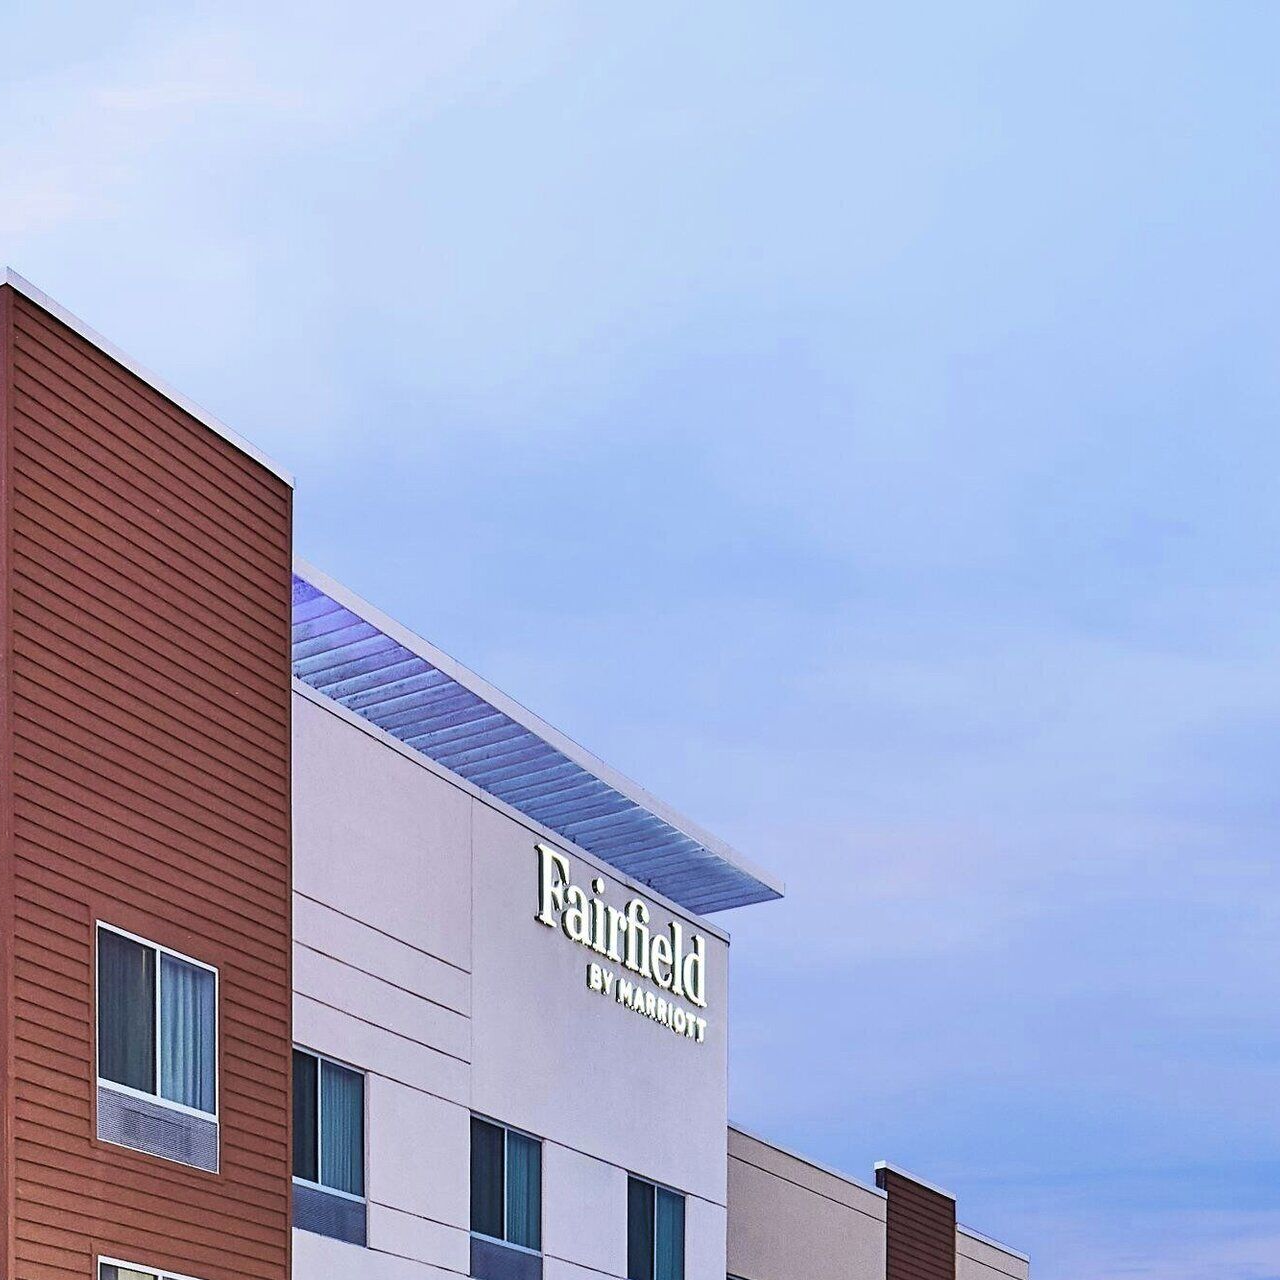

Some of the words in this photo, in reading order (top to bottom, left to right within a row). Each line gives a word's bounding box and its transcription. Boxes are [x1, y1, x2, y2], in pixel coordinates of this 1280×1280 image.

[535, 843, 708, 1008] Fairfield
[587, 963, 614, 995] BY
[616, 979, 708, 1043] MARRIOTT
